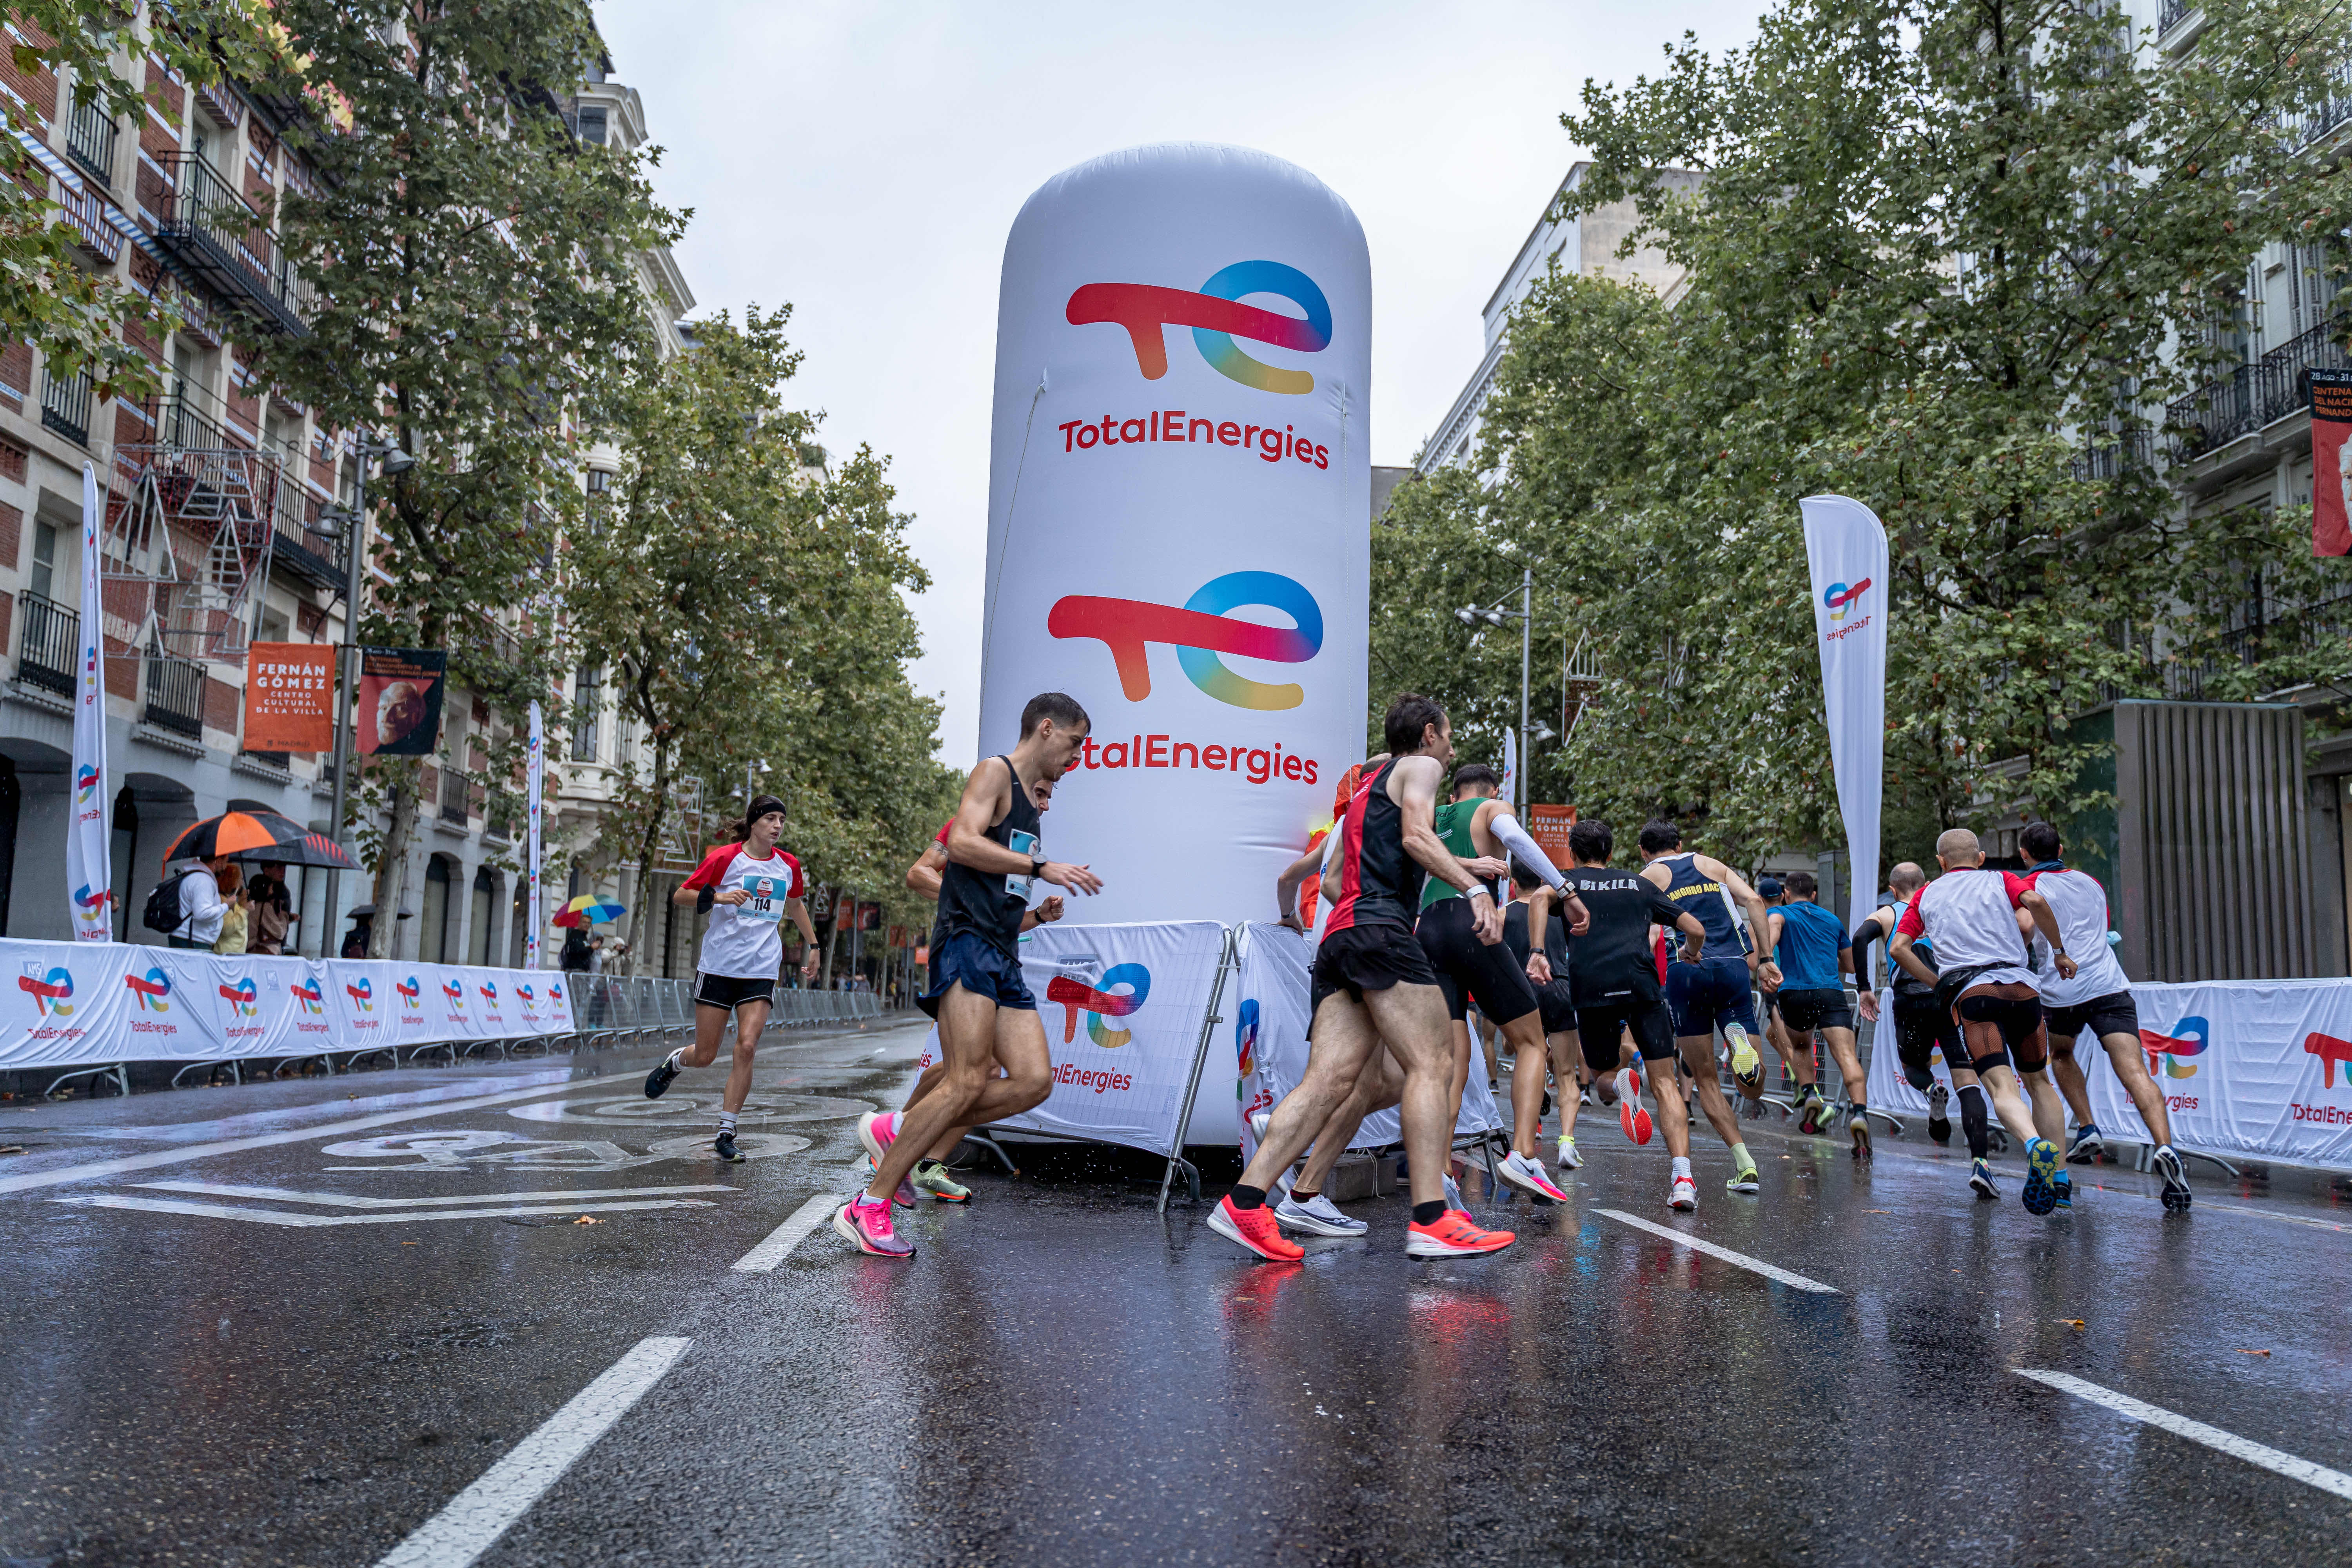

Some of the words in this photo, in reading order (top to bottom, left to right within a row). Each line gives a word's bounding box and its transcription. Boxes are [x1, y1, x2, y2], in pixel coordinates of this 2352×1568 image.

[2311, 372, 2320, 380] 28
[2340, 373, 2348, 381] 31
[2314, 396, 2327, 405] DEL
[2327, 397, 2352, 406] NACI
[1058, 411, 1329, 470] TotalEnergies
[258, 662, 325, 676] FERNÁN
[258, 675, 325, 689] GÓMEZ
[1066, 734, 1318, 785] talEnergies
[1536, 816, 1571, 824] FERNÁN
[1537, 824, 1571, 832] GÓMEZ
[1580, 879, 1639, 891] BIKILA
[1703, 883, 1720, 892] AAC
[755, 898, 771, 911] 114
[130, 1021, 177, 1035] TotalEnergies
[1051, 1063, 1132, 1094] alEnergies
